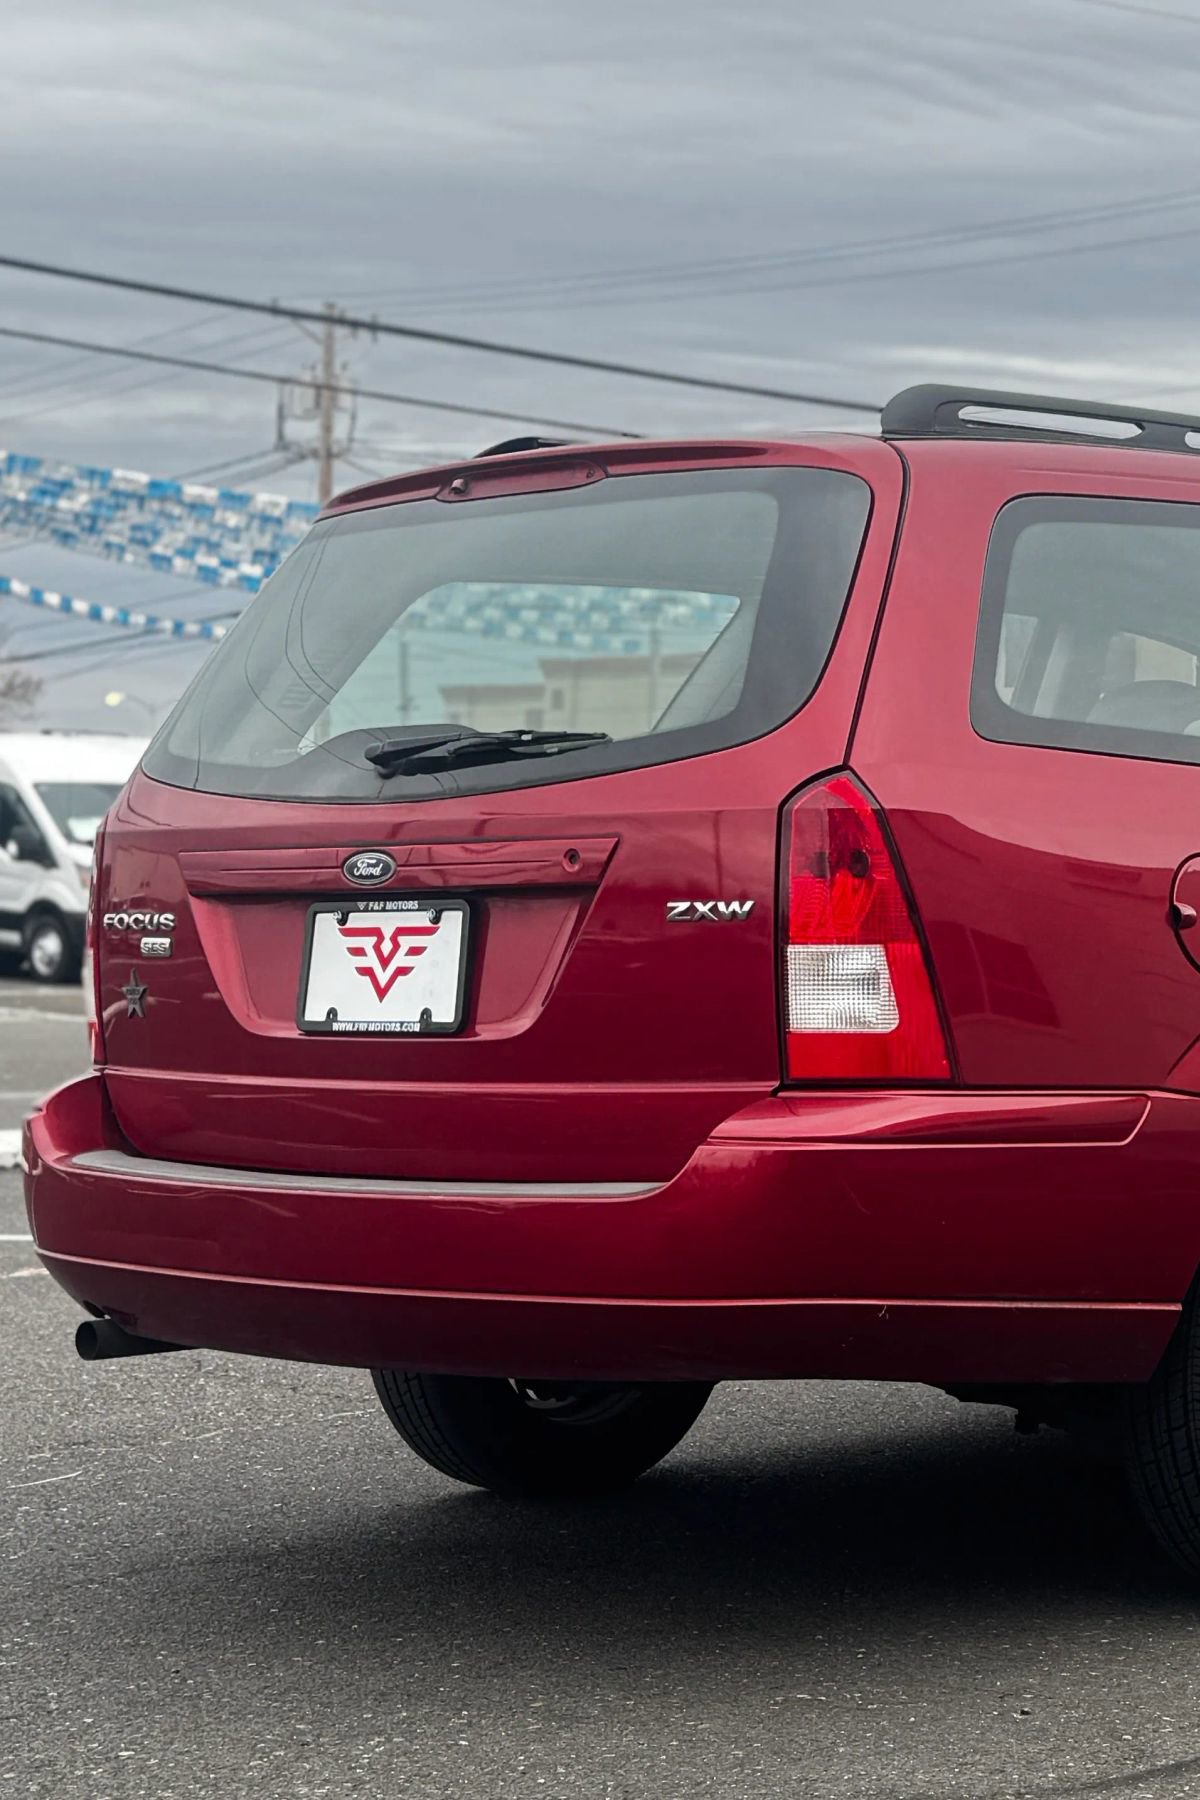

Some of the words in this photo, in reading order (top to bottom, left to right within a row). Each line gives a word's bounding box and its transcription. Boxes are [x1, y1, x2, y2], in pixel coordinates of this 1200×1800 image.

[353, 859, 384, 876] Ford
[385, 900, 419, 910] MOTORS
[666, 900, 755, 921] ZXW
[103, 912, 176, 930] FOCUS
